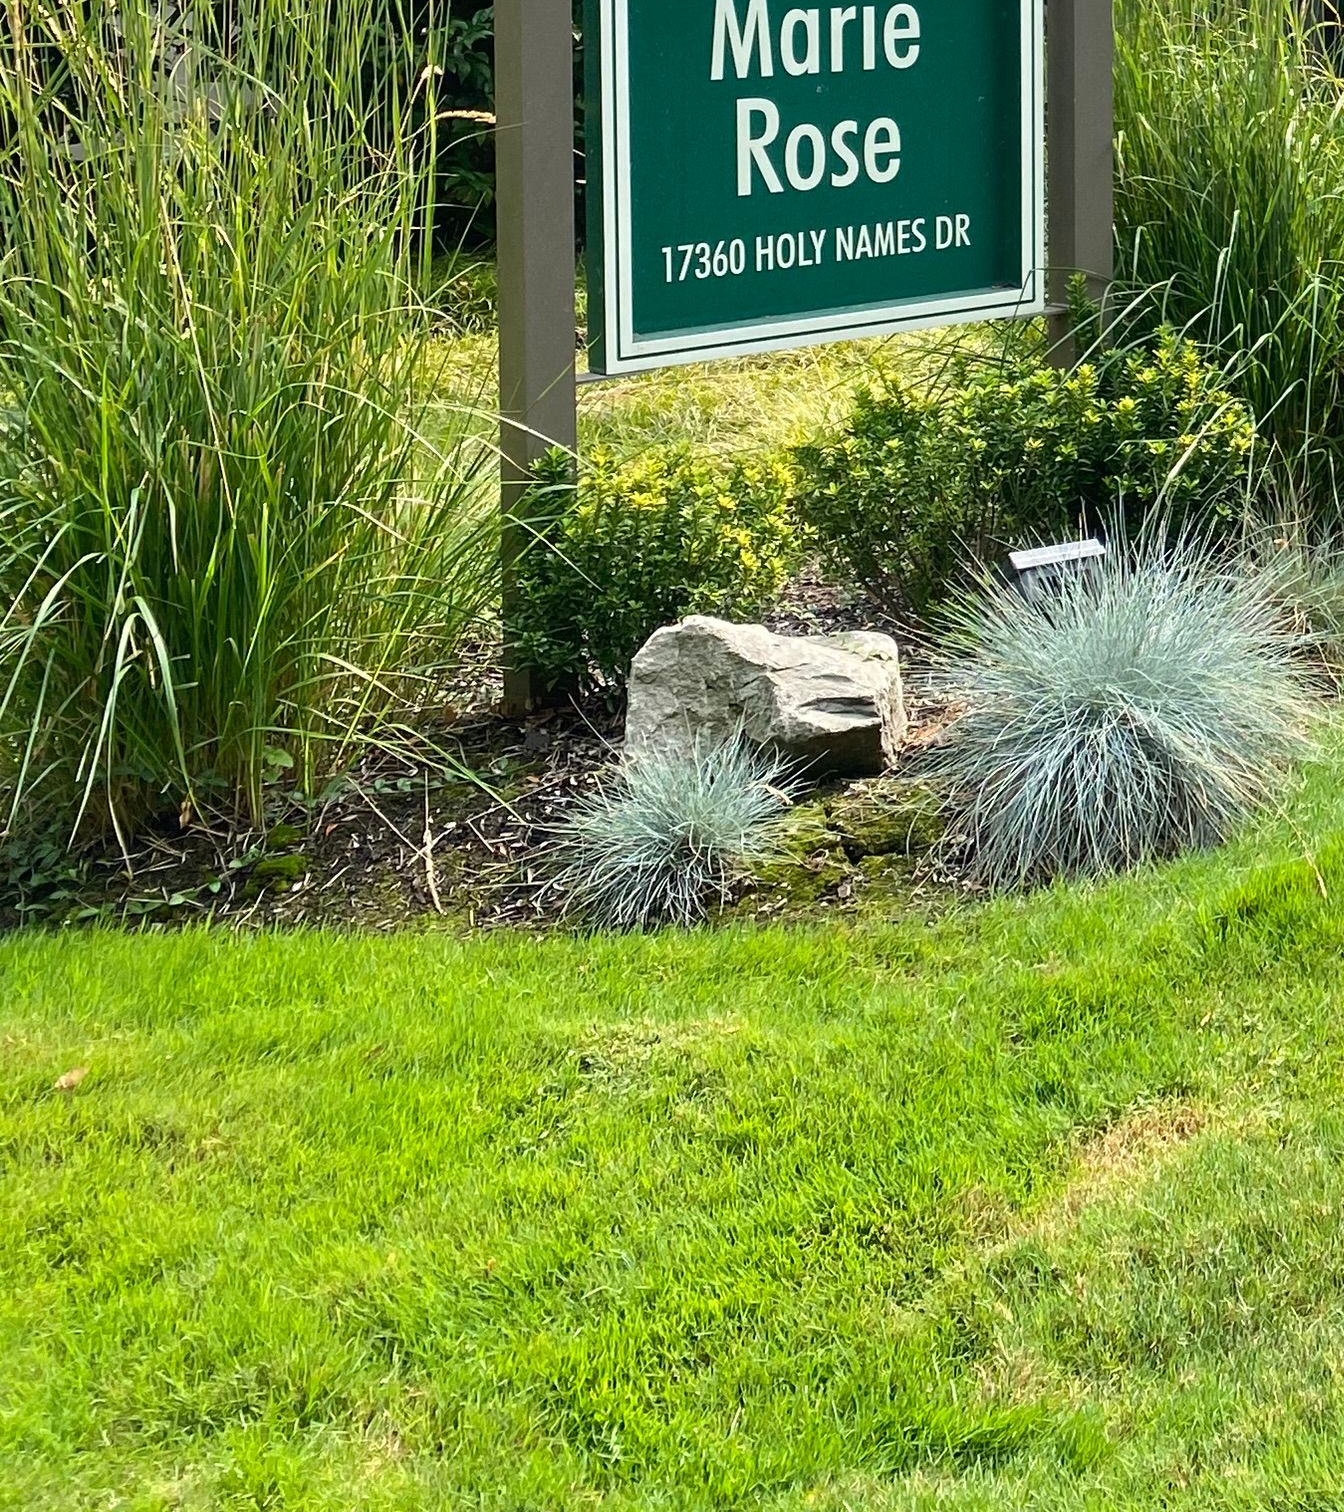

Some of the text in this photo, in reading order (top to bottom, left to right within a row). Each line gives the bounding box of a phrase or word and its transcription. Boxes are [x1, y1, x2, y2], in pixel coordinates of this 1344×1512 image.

[735, 97, 902, 196] Rose
[661, 213, 972, 284] 17360 HOLY NAMES DR
